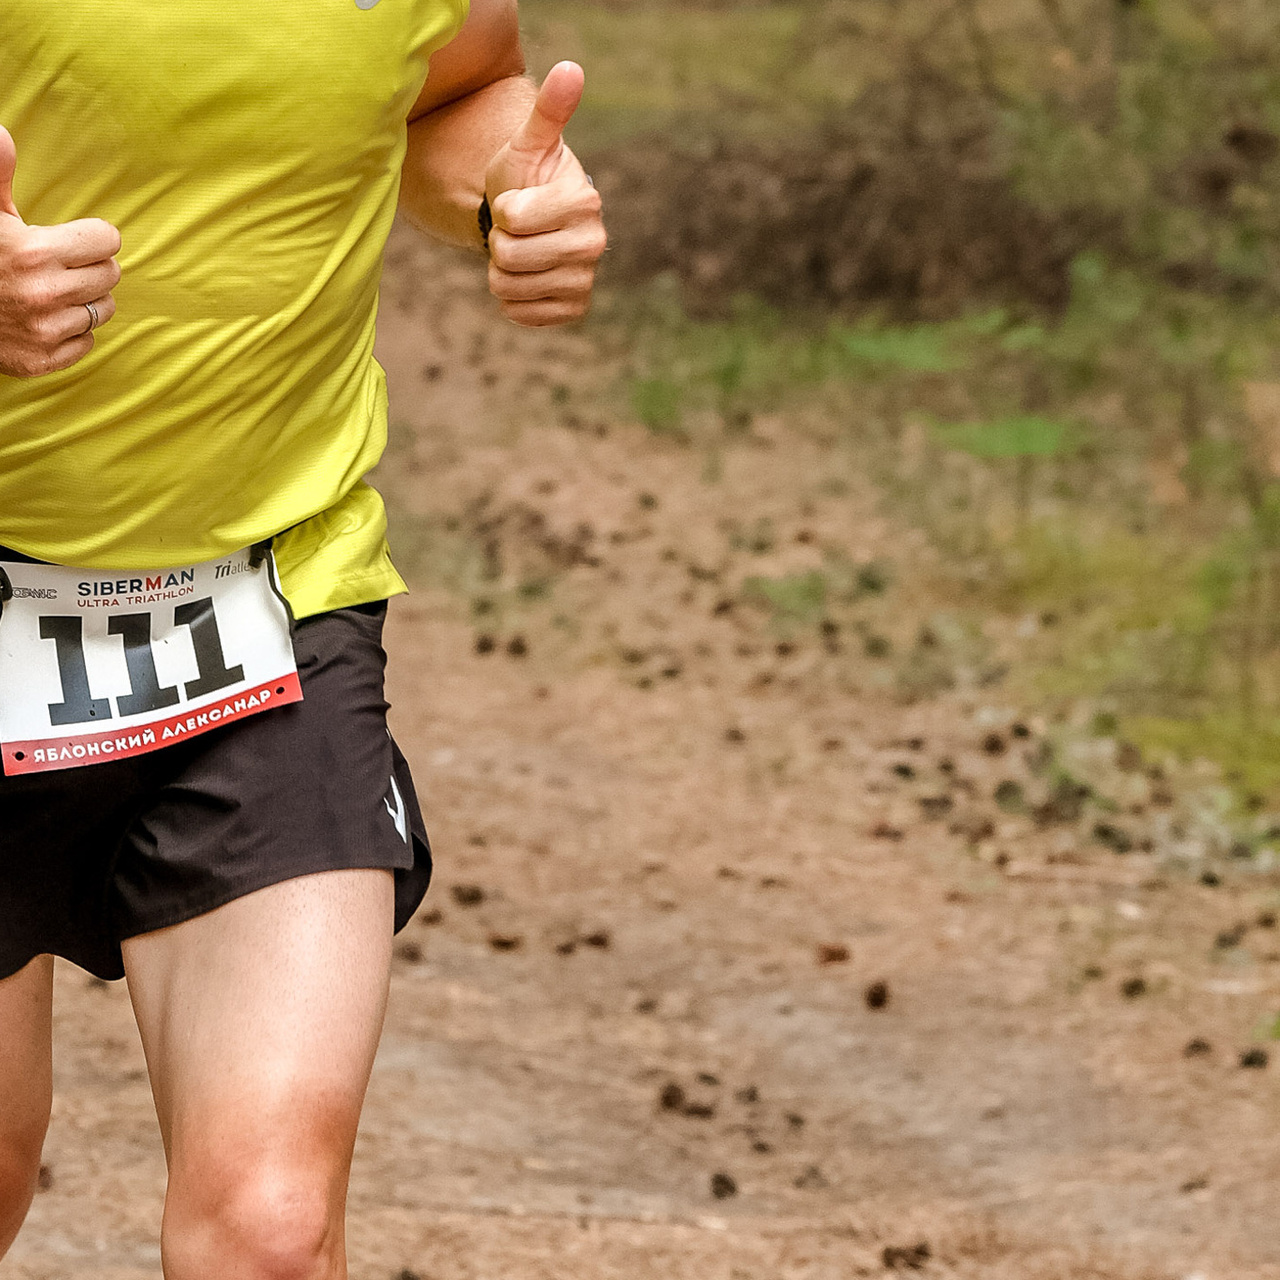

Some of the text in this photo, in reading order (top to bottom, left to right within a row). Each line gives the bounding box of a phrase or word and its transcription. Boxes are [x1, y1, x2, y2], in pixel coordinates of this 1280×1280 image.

[77, 568, 195, 596] SIBERMAN
[215, 560, 252, 579] Triatle
[77, 585, 194, 608] ULTRA TRIATHLON
[39, 596, 245, 726] 111
[33, 689, 272, 763] ЯБЛОНСКИЙ АЛЕКСАНДР
